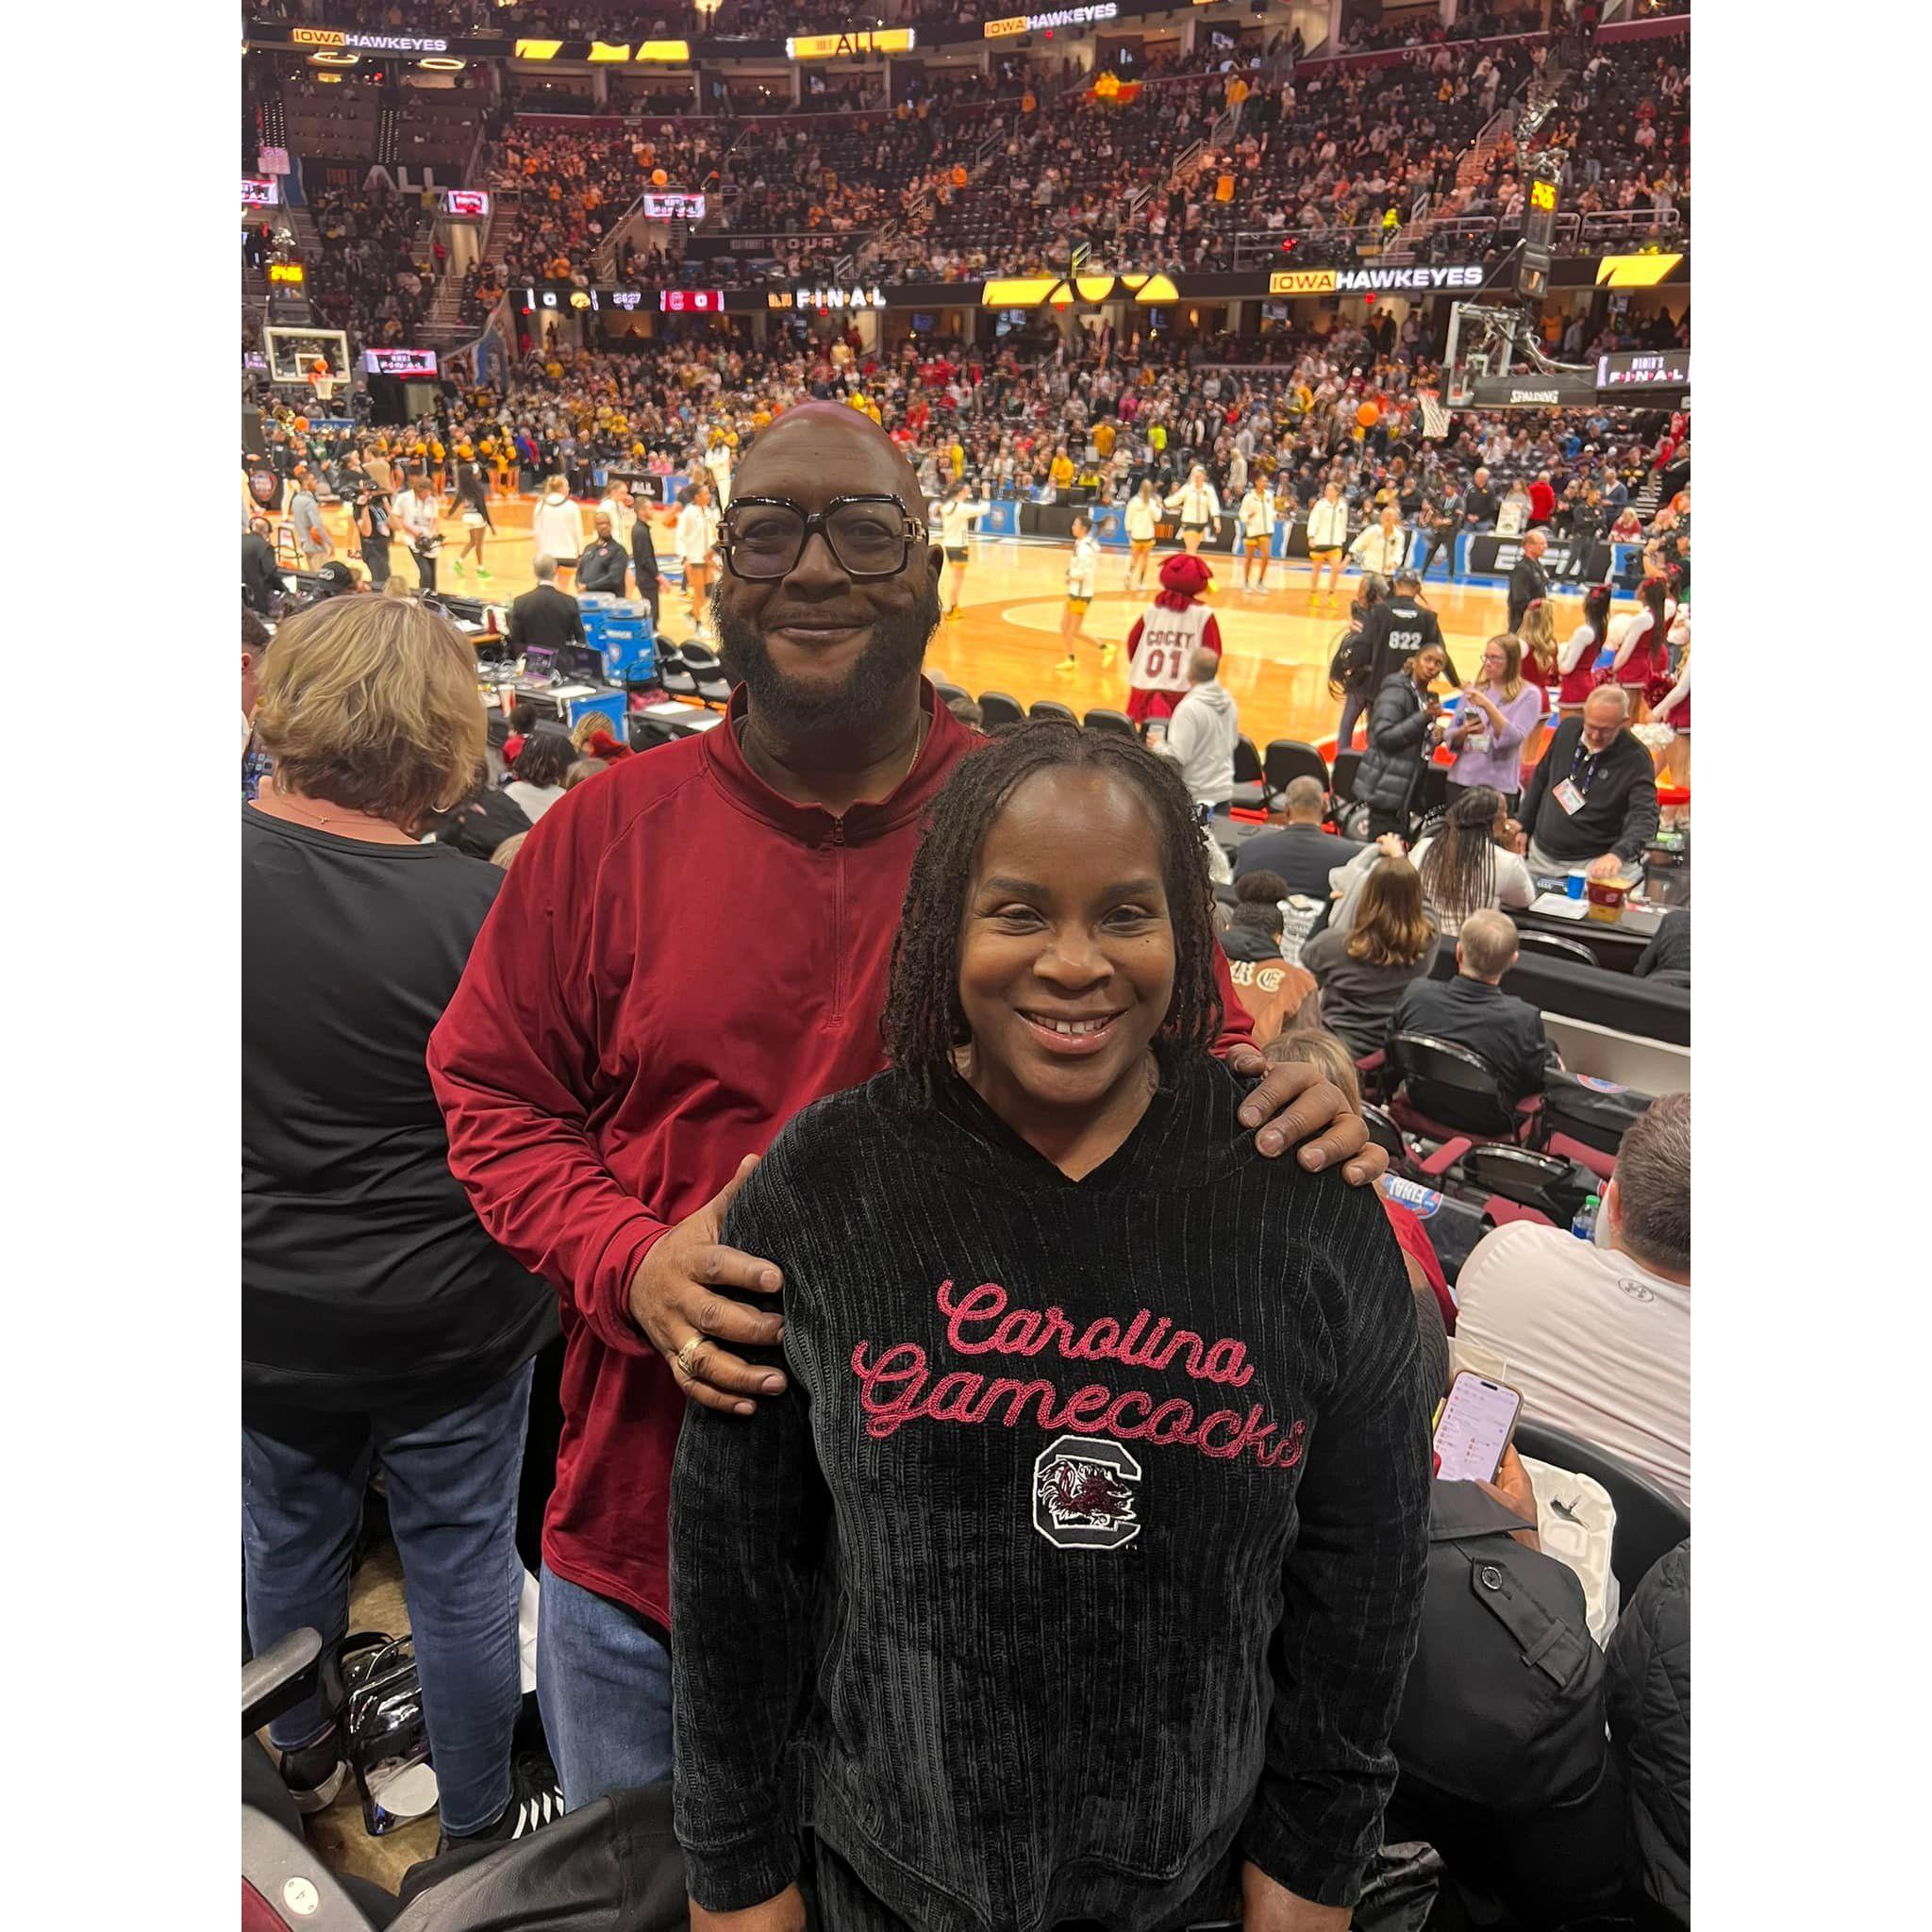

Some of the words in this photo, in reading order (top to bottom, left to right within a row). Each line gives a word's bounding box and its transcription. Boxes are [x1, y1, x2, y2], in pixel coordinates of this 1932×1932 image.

[986, 18, 1025, 35] IOWA
[1025, 2, 1117, 29] HAWKEYES
[294, 29, 343, 44] IOWA
[345, 33, 447, 51] HAWKEYES
[362, 164, 448, 193] ALL
[1273, 275, 1332, 291] IOWA
[1335, 266, 1484, 289] HAWKEYES
[1608, 369, 1684, 384] FINAL
[1509, 389, 1559, 405] SPALDING
[1146, 630, 1195, 650] COCKY
[1388, 630, 1423, 651] 822
[1145, 648, 1182, 680] 01
[937, 1278, 1255, 1388] Carolina
[851, 1341, 1307, 1470] Gamecocks
